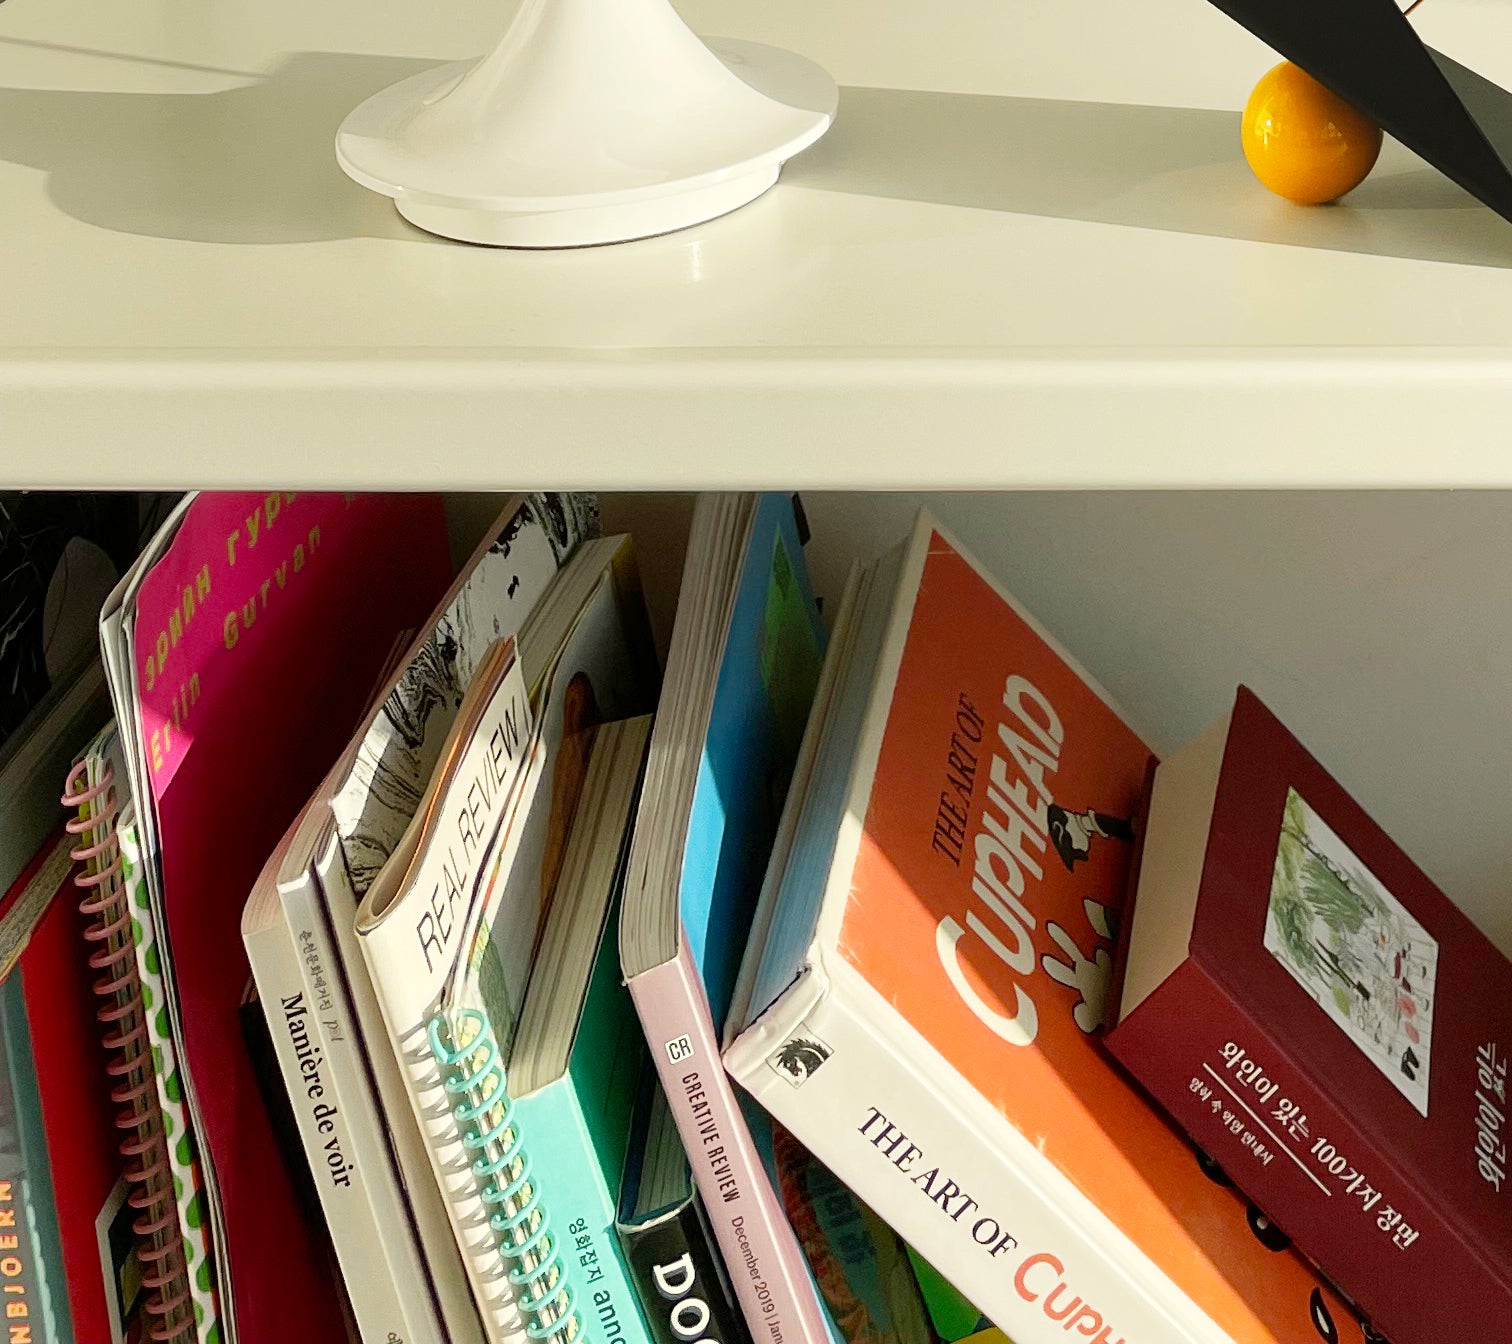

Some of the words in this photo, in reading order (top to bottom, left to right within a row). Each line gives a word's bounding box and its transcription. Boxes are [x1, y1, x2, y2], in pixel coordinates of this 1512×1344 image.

[222, 524, 321, 650] Gurvan
[956, 692, 986, 744] OF
[946, 734, 980, 812] ART
[416, 846, 468, 974] REAL
[458, 695, 518, 865] REVIEW
[932, 792, 972, 868] THE
[281, 991, 325, 1100] Manière
[668, 1037, 693, 1061] CR
[1476, 1042, 1507, 1105] 있는
[313, 1102, 338, 1135] de
[1218, 1041, 1280, 1104] 와인이
[1270, 1097, 1310, 1143] 있는
[1309, 1136, 1383, 1212] 100가지
[1376, 1204, 1420, 1251] 장면
[1475, 1089, 1506, 1193] 와인이
[324, 1136, 354, 1188] voir
[682, 1072, 720, 1146] CREATIVE
[706, 1143, 741, 1204] REVIEW
[731, 1215, 762, 1280] December
[754, 1281, 775, 1313] 2019
[856, 1106, 924, 1174] THE
[910, 1167, 979, 1224] ART
[971, 1216, 1018, 1258] OF
[568, 1217, 605, 1285] 영화잡지
